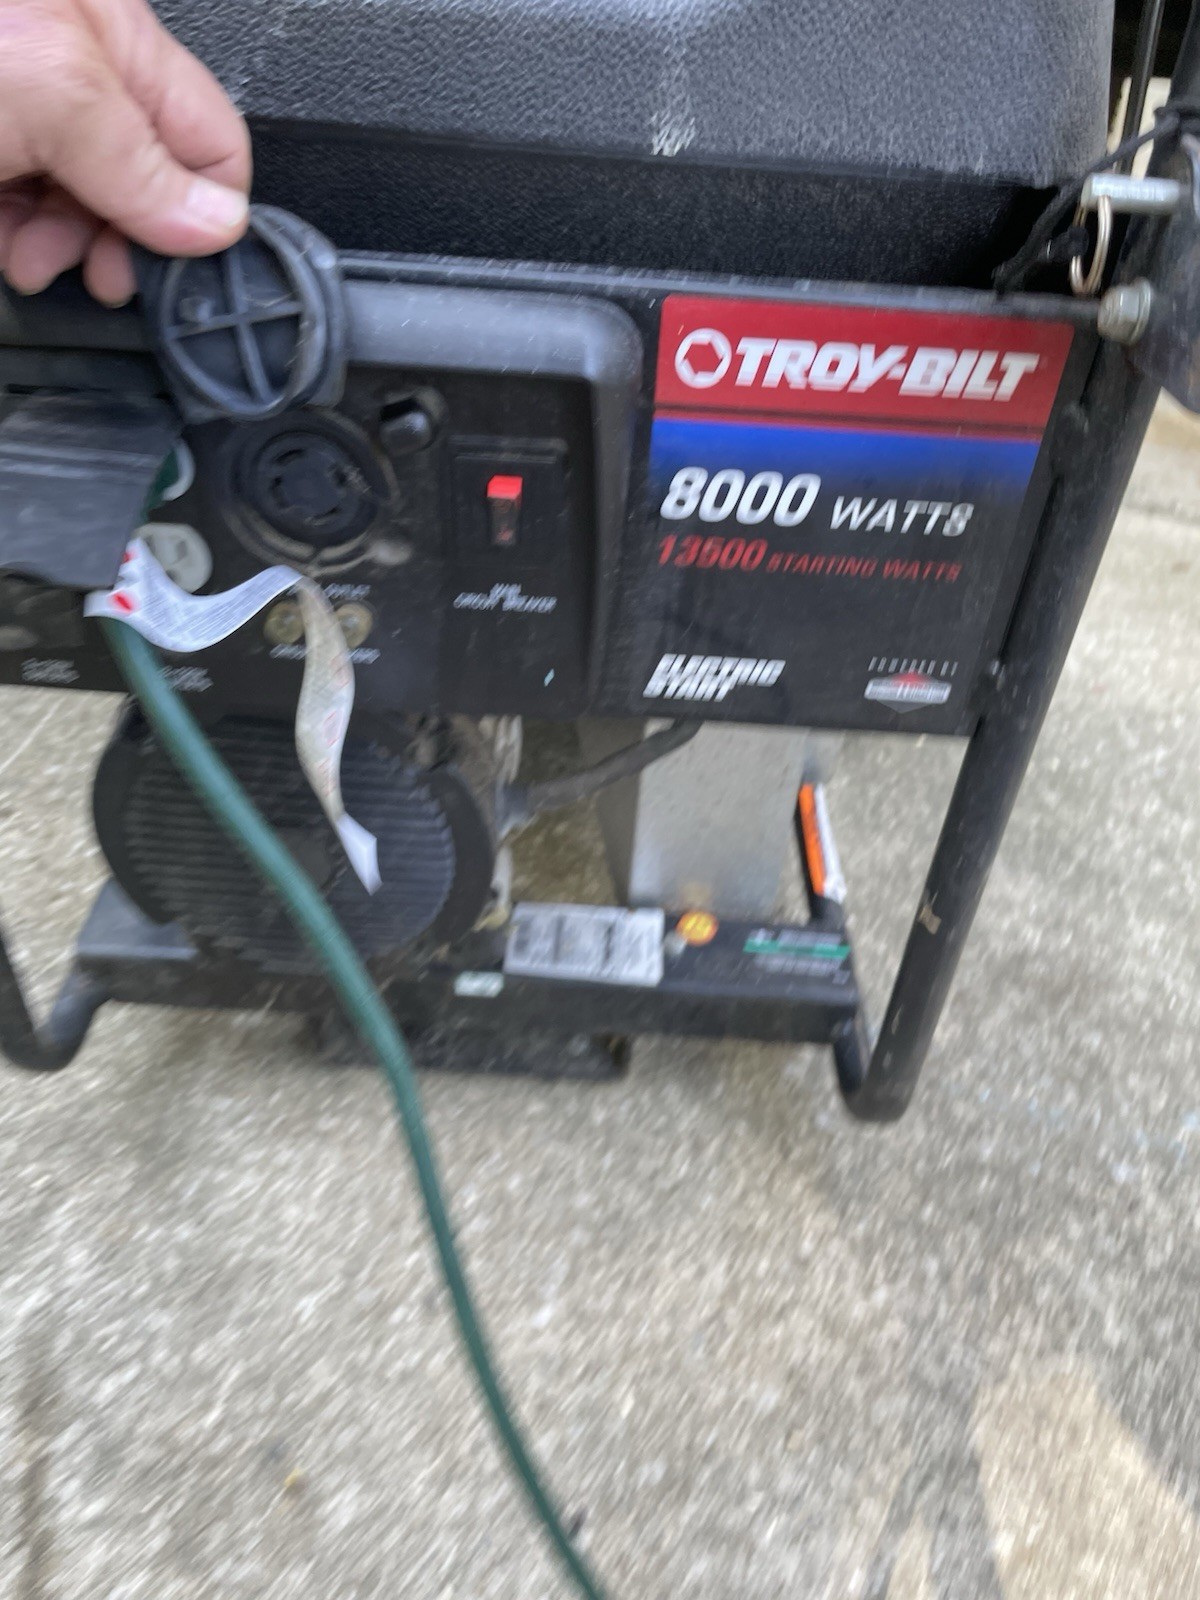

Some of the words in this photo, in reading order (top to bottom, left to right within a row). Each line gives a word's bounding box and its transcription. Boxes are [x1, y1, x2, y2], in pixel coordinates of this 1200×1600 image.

[735, 336, 1040, 401] TROY-BILT
[659, 466, 821, 528] 8000
[829, 495, 974, 537] WATTS
[658, 534, 768, 572] 13500
